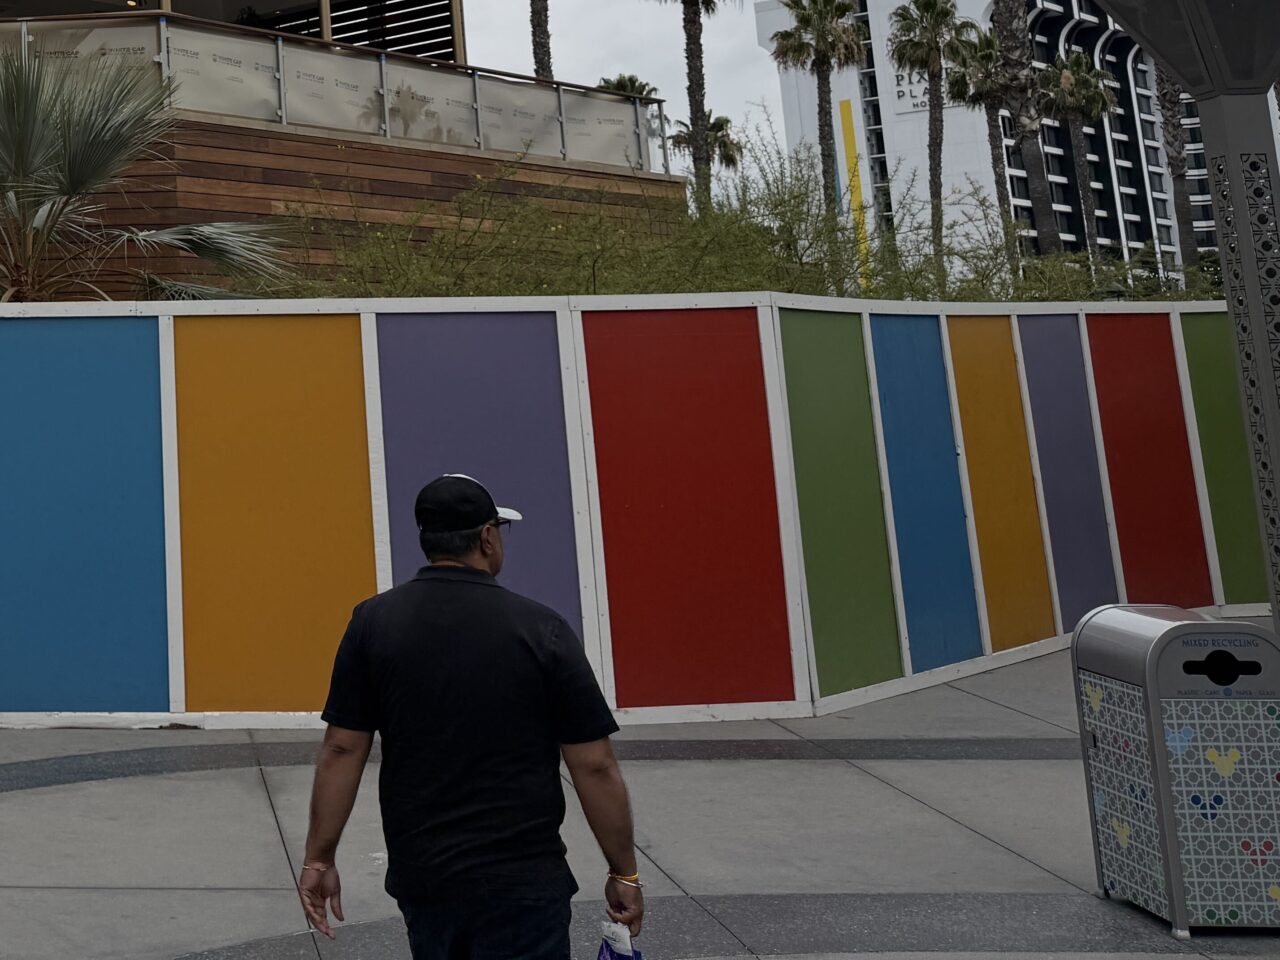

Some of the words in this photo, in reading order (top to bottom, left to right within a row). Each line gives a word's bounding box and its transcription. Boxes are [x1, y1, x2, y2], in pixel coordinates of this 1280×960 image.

[895, 67, 958, 86] PIX
[896, 85, 945, 100] PLA
[1182, 638, 1209, 648] MIXED
[1211, 638, 1259, 648] RECYCLING
